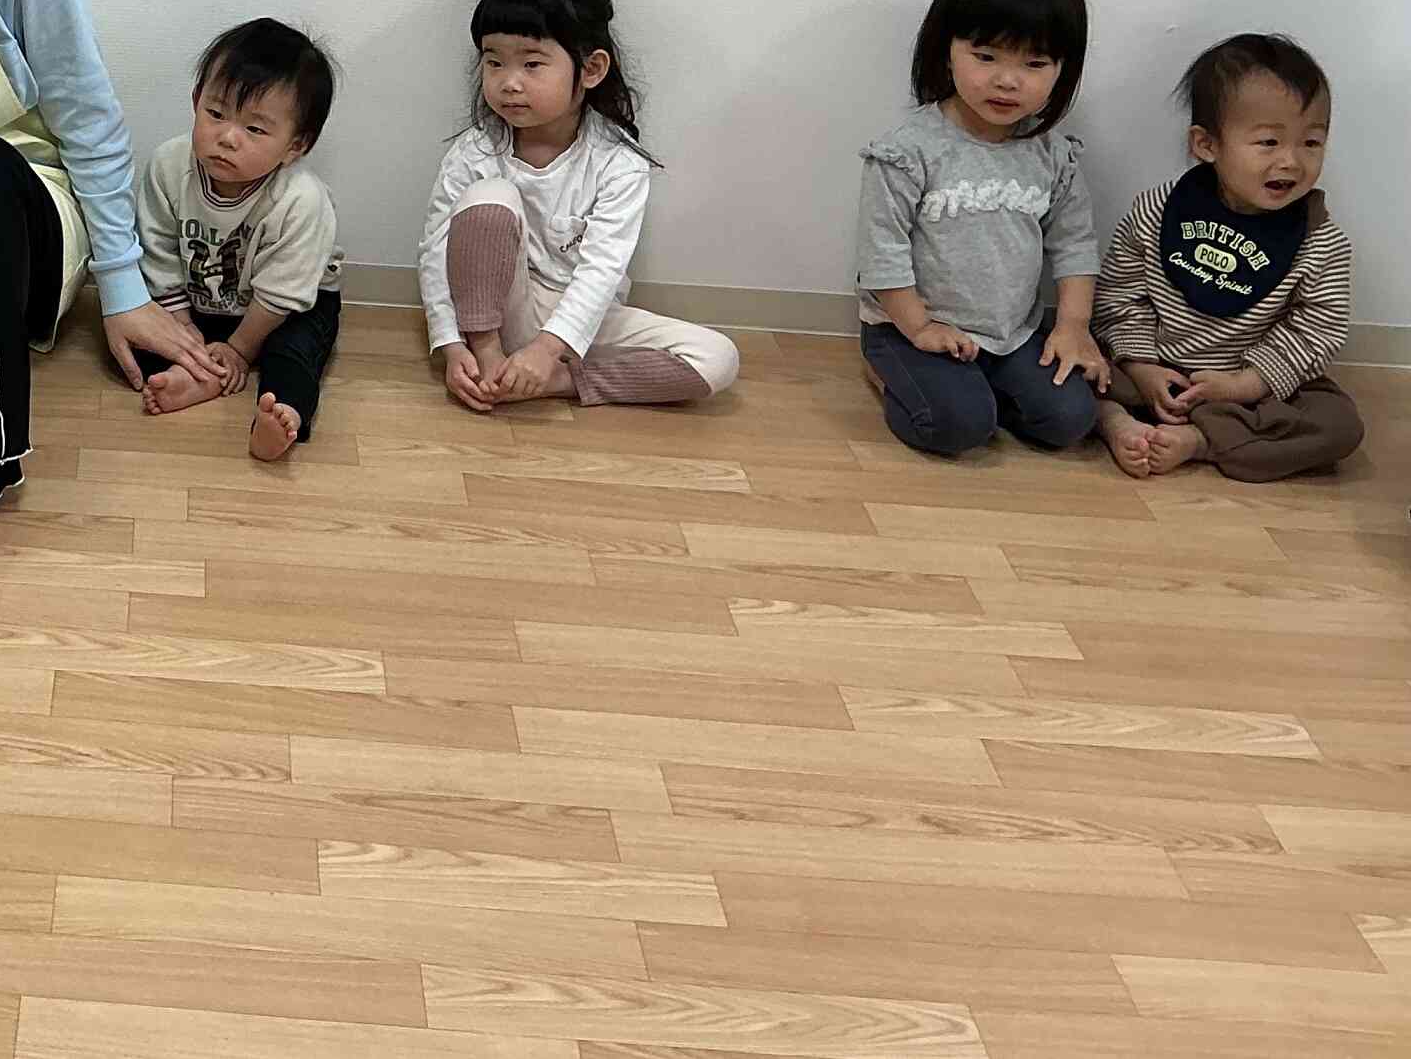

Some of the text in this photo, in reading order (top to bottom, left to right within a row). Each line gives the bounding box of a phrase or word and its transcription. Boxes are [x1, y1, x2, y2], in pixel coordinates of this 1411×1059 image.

[1180, 220, 1271, 271] BRITISH
[1200, 248, 1229, 270] POLO
[1168, 251, 1253, 295] Country Spirit
